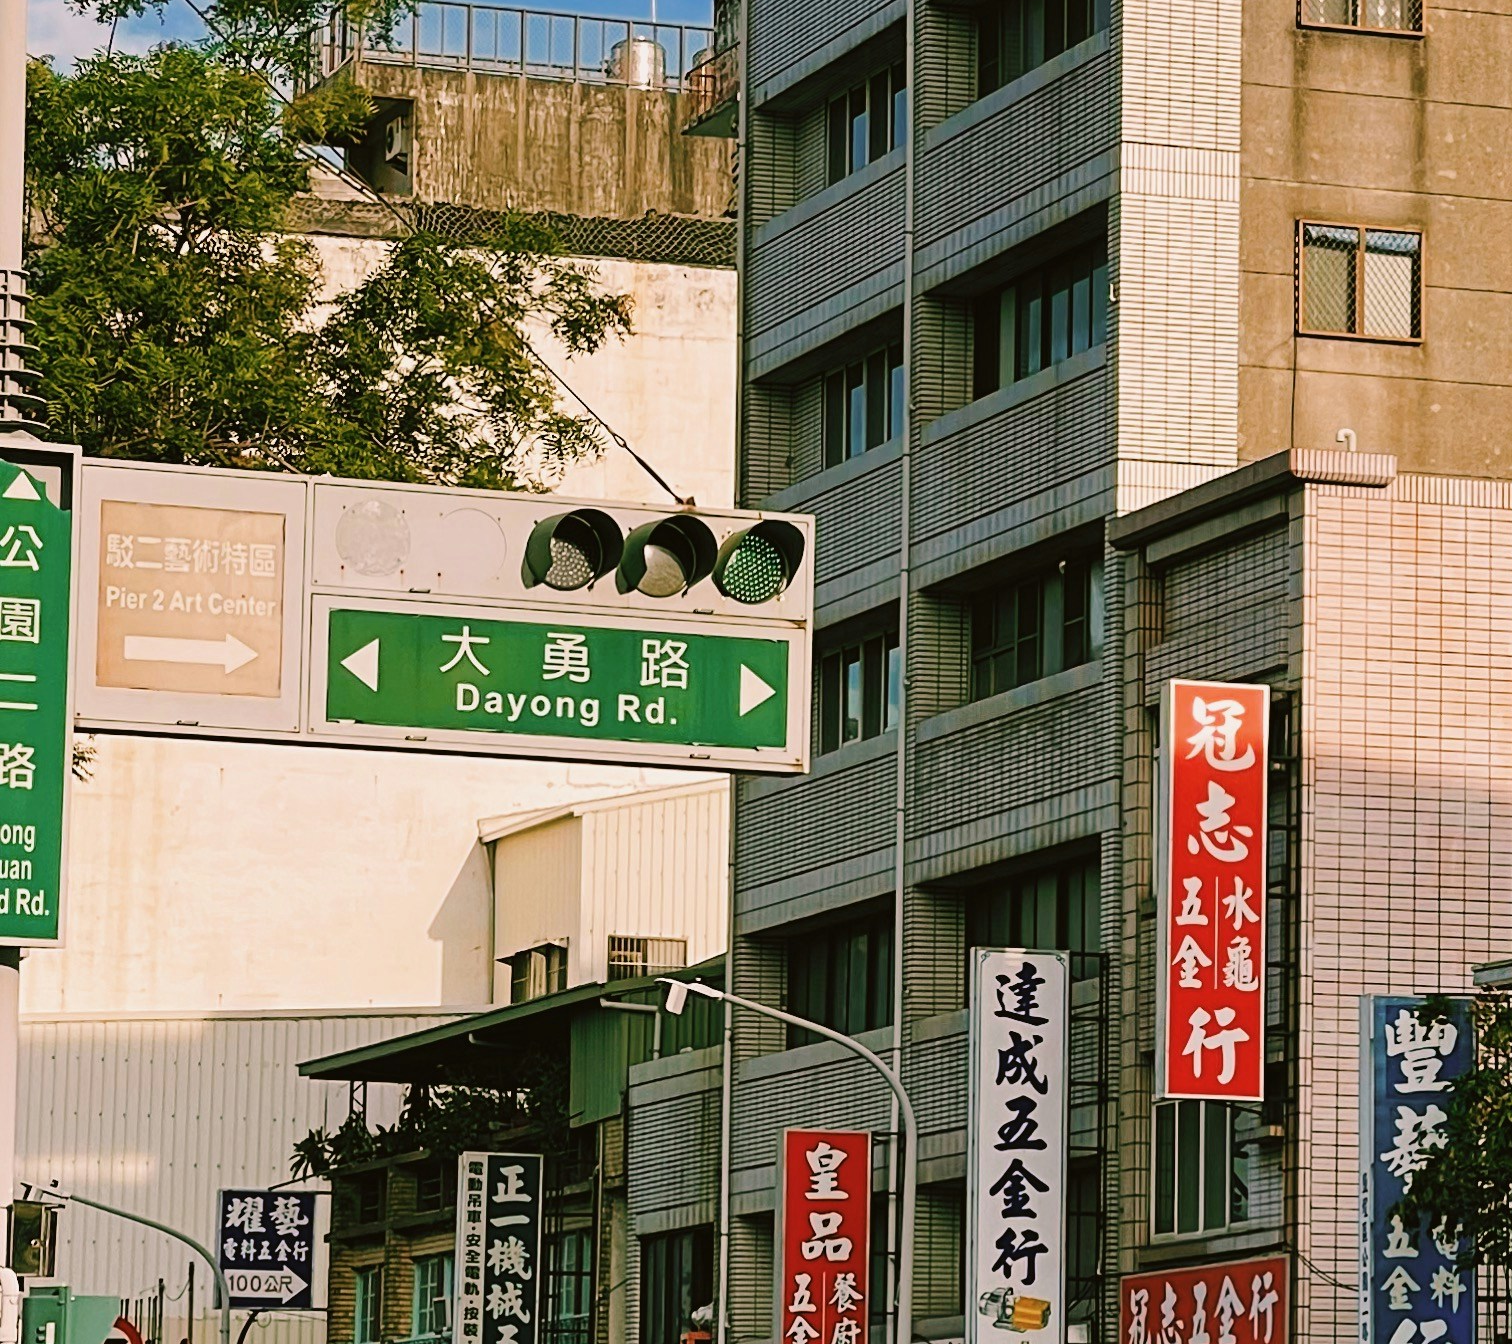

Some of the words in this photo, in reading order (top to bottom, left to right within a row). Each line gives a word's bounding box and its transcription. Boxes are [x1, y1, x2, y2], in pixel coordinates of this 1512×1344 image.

[106, 533, 277, 579] 駁二藝術特區
[106, 585, 148, 609] Pier
[153, 588, 165, 612] 2
[169, 589, 203, 614] Art
[207, 592, 277, 618] Center
[0, 524, 43, 790] 公園二路
[439, 625, 690, 690] 大勇路
[456, 683, 600, 728] Dayong
[616, 693, 678, 726] Rd.
[1184, 695, 1257, 863] 冠志
[0, 820, 36, 853] ong
[15, 890, 50, 917] Rd.
[1171, 875, 1213, 990] 五金
[1221, 875, 1261, 993] 水龜
[1181, 1005, 1251, 1086] 行
[989, 961, 1050, 1287] 達成五金行
[225, 1196, 310, 1237] 耀藝
[801, 1142, 853, 1262] 皇品
[223, 1237, 309, 1262] 電料五金行
[228, 1274, 294, 1294] 100公尺
